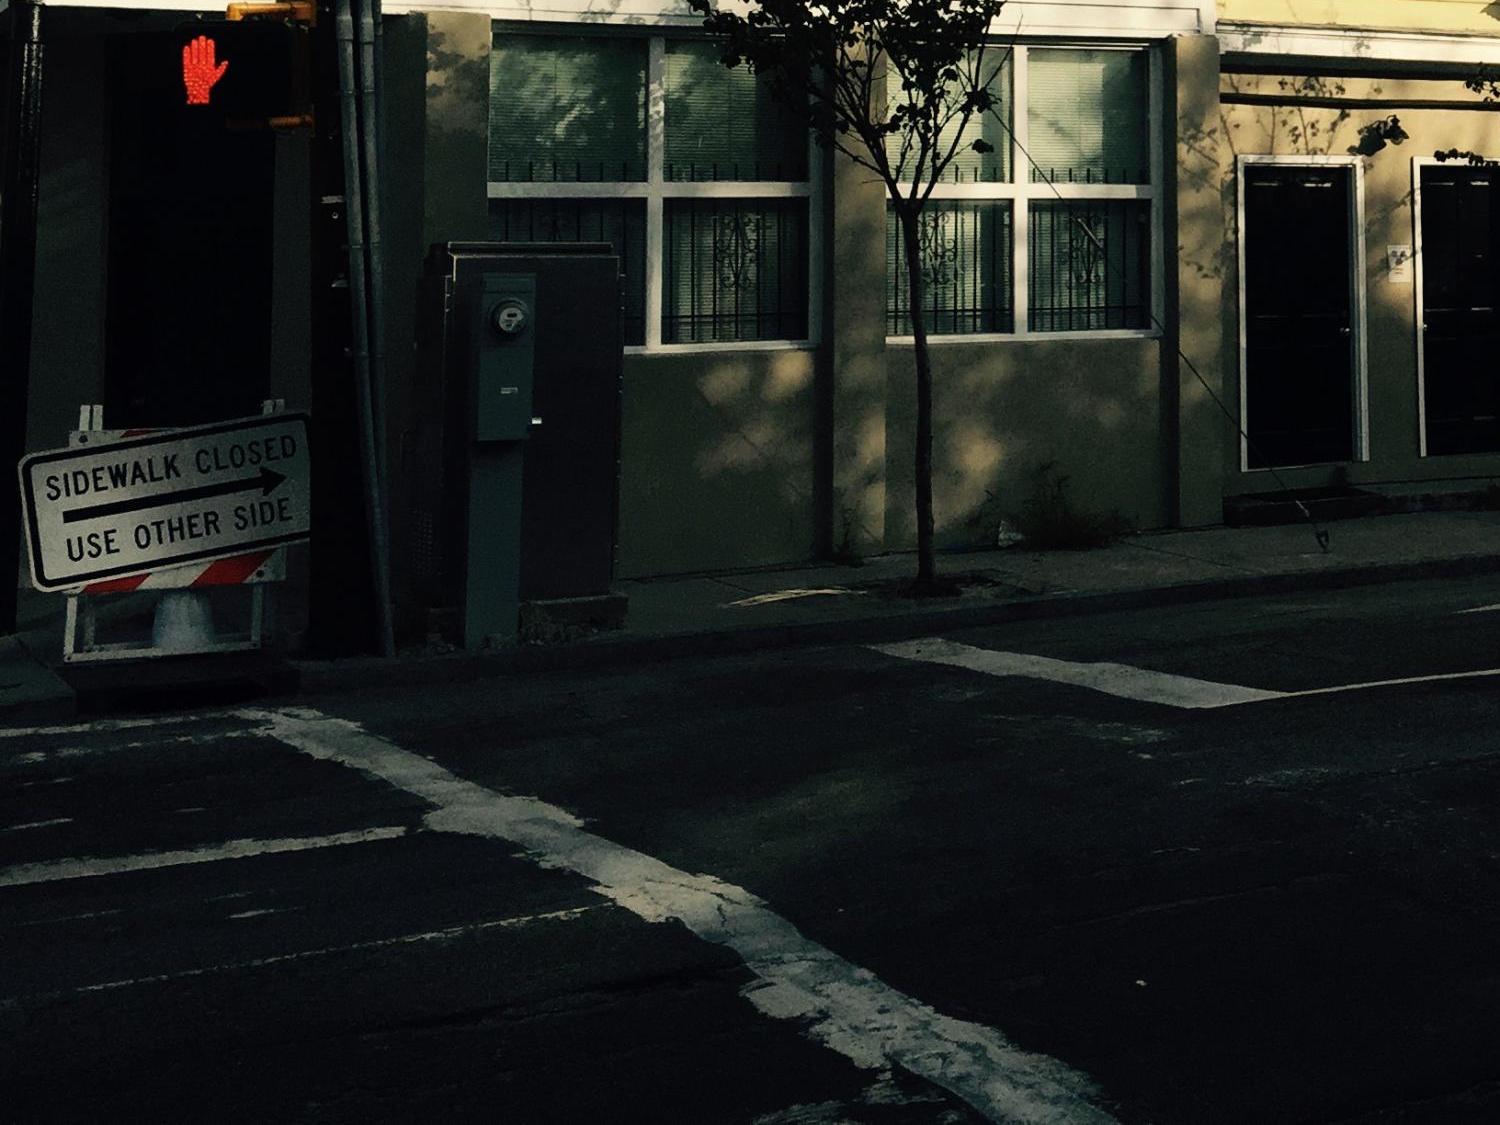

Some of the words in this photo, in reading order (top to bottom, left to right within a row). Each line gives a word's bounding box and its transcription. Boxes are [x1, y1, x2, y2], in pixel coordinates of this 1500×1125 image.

[46, 454, 181, 500] SIDEWALK
[195, 435, 296, 475] CLOSED
[66, 529, 120, 562] USE
[134, 511, 220, 550] OTHER
[234, 497, 293, 530] SIDE
